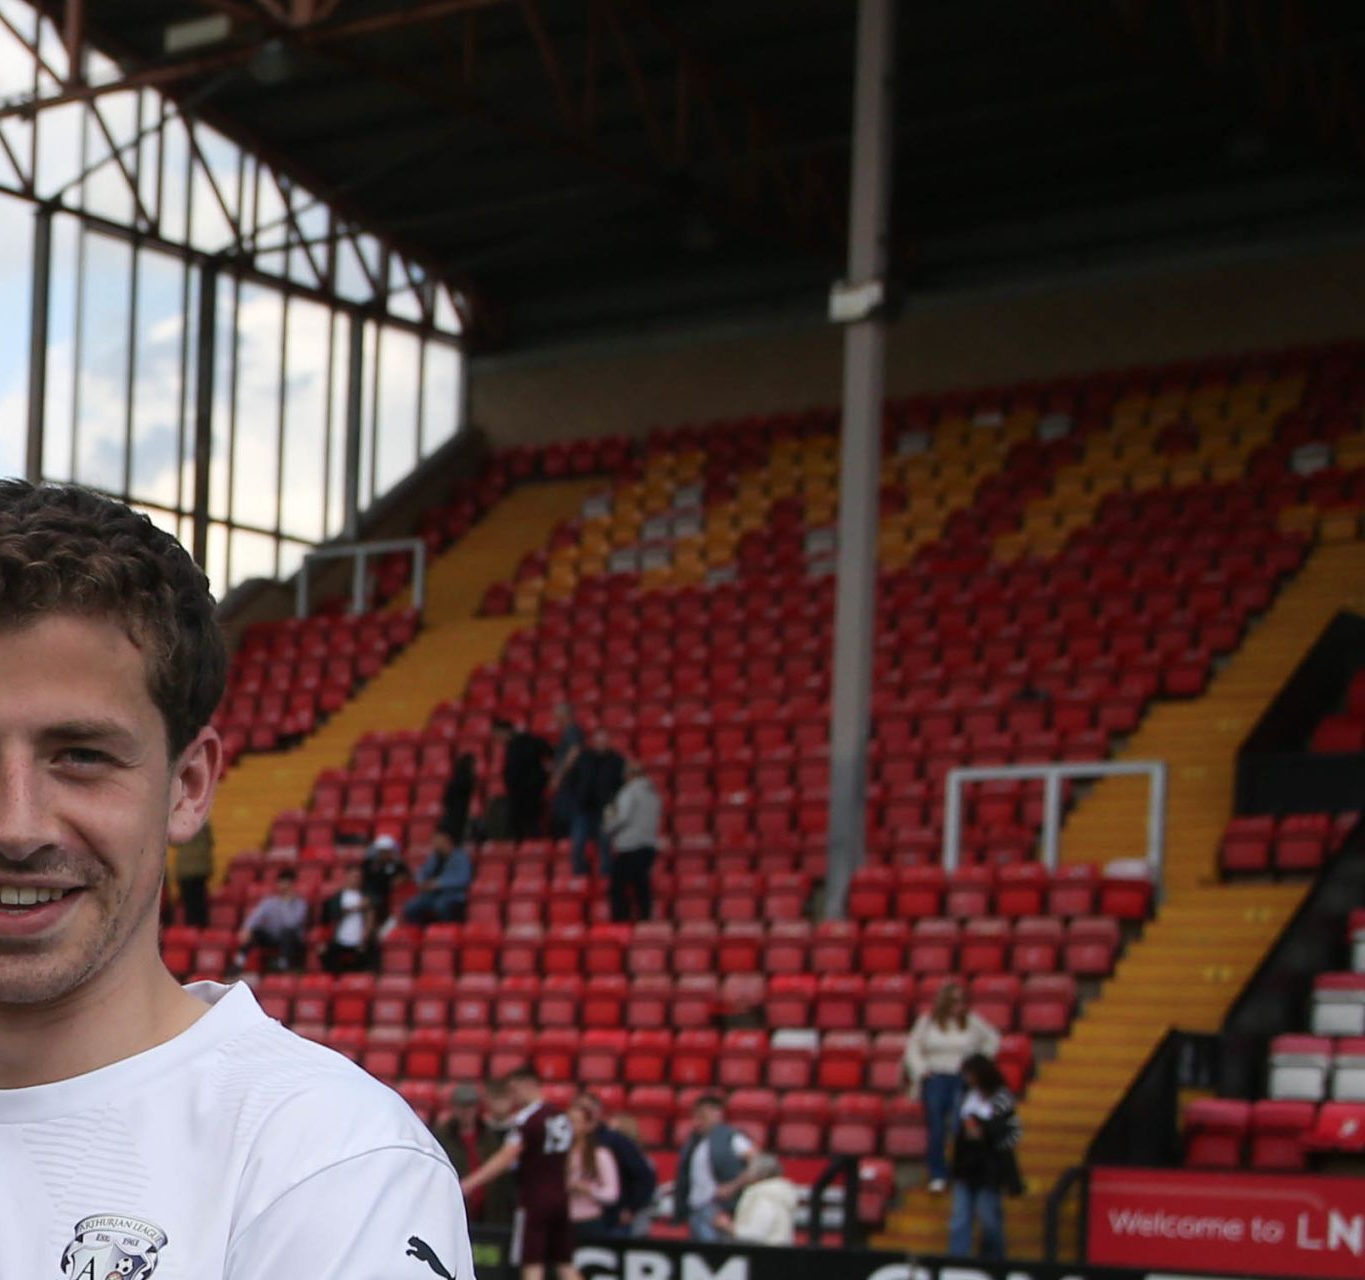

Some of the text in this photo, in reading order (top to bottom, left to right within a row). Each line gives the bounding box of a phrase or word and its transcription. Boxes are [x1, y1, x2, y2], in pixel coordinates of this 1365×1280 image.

[79, 1218, 164, 1244] ARTHURIAN LEAGUE
[1109, 1210, 1243, 1241] Welcome
[1252, 1216, 1286, 1242] to
